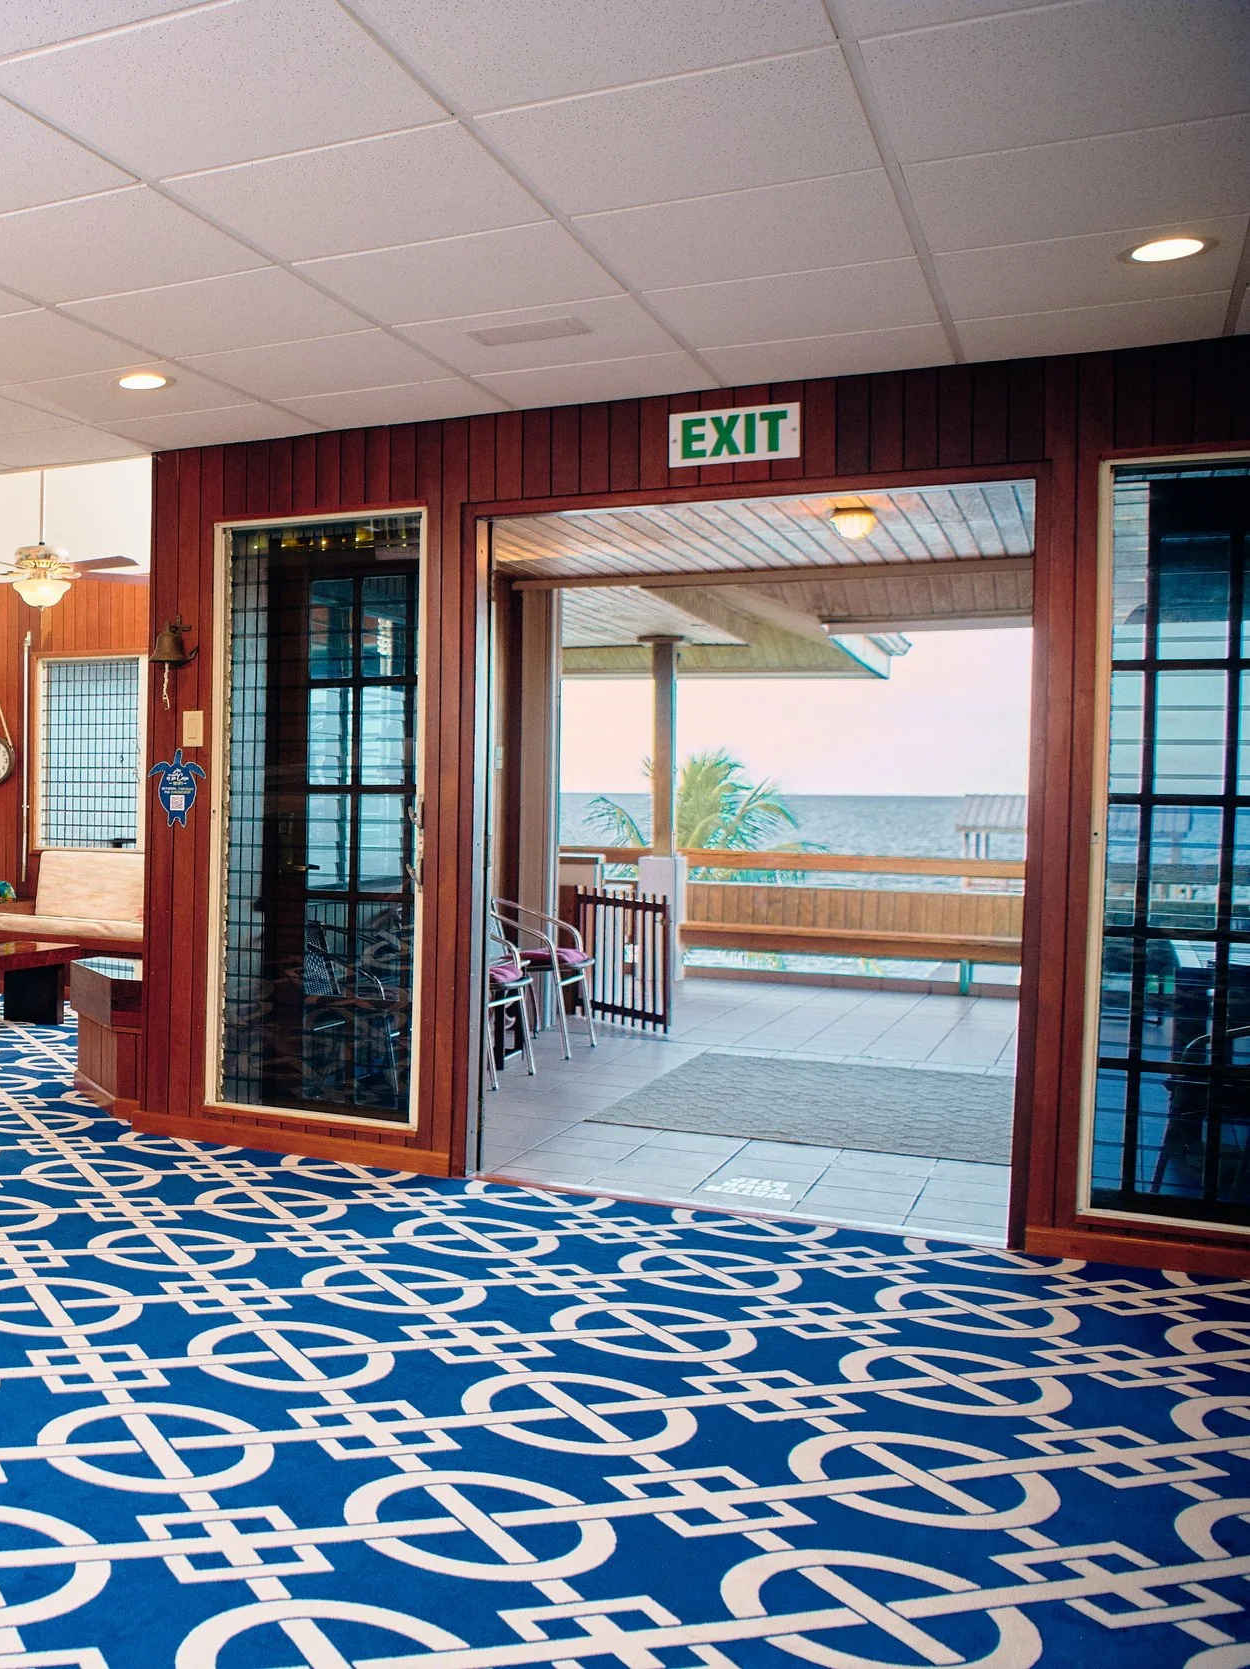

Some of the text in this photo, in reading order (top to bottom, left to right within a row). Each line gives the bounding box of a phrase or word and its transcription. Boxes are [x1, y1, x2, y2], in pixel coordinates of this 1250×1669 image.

[681, 410, 788, 460] EXIT
[703, 1184, 791, 1200] WATCH
[721, 1181, 784, 1194] YOUR
